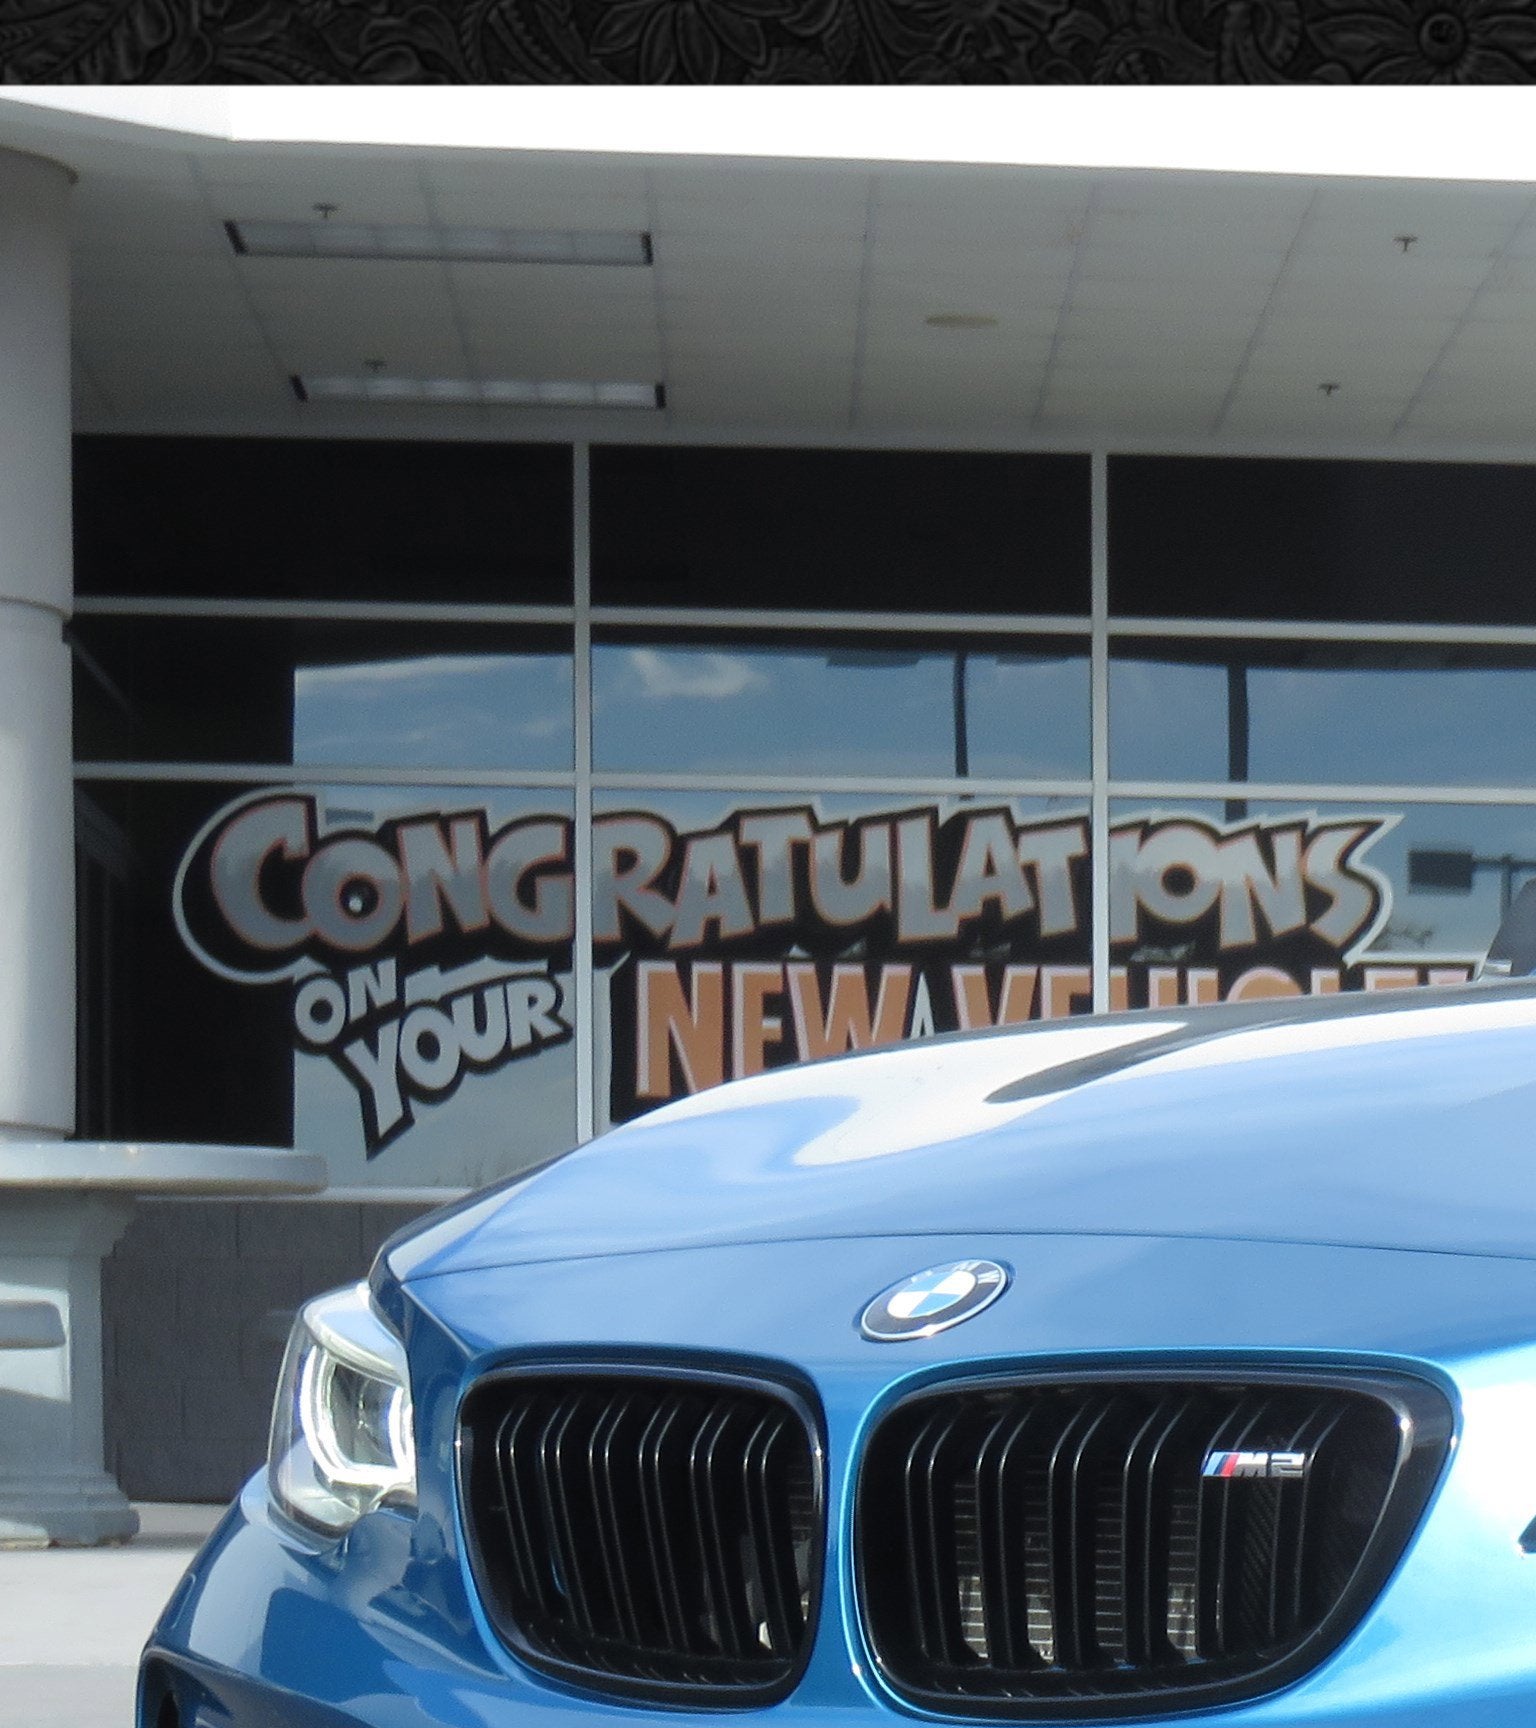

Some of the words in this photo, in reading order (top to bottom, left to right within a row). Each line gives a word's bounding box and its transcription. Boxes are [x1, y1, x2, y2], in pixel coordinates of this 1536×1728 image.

[206, 796, 1387, 953] CONGRATULATIONS
[293, 957, 398, 1046] ON
[344, 972, 568, 1141] YOUR
[635, 960, 913, 1098] NEW
[1228, 1450, 1306, 1478] M2
